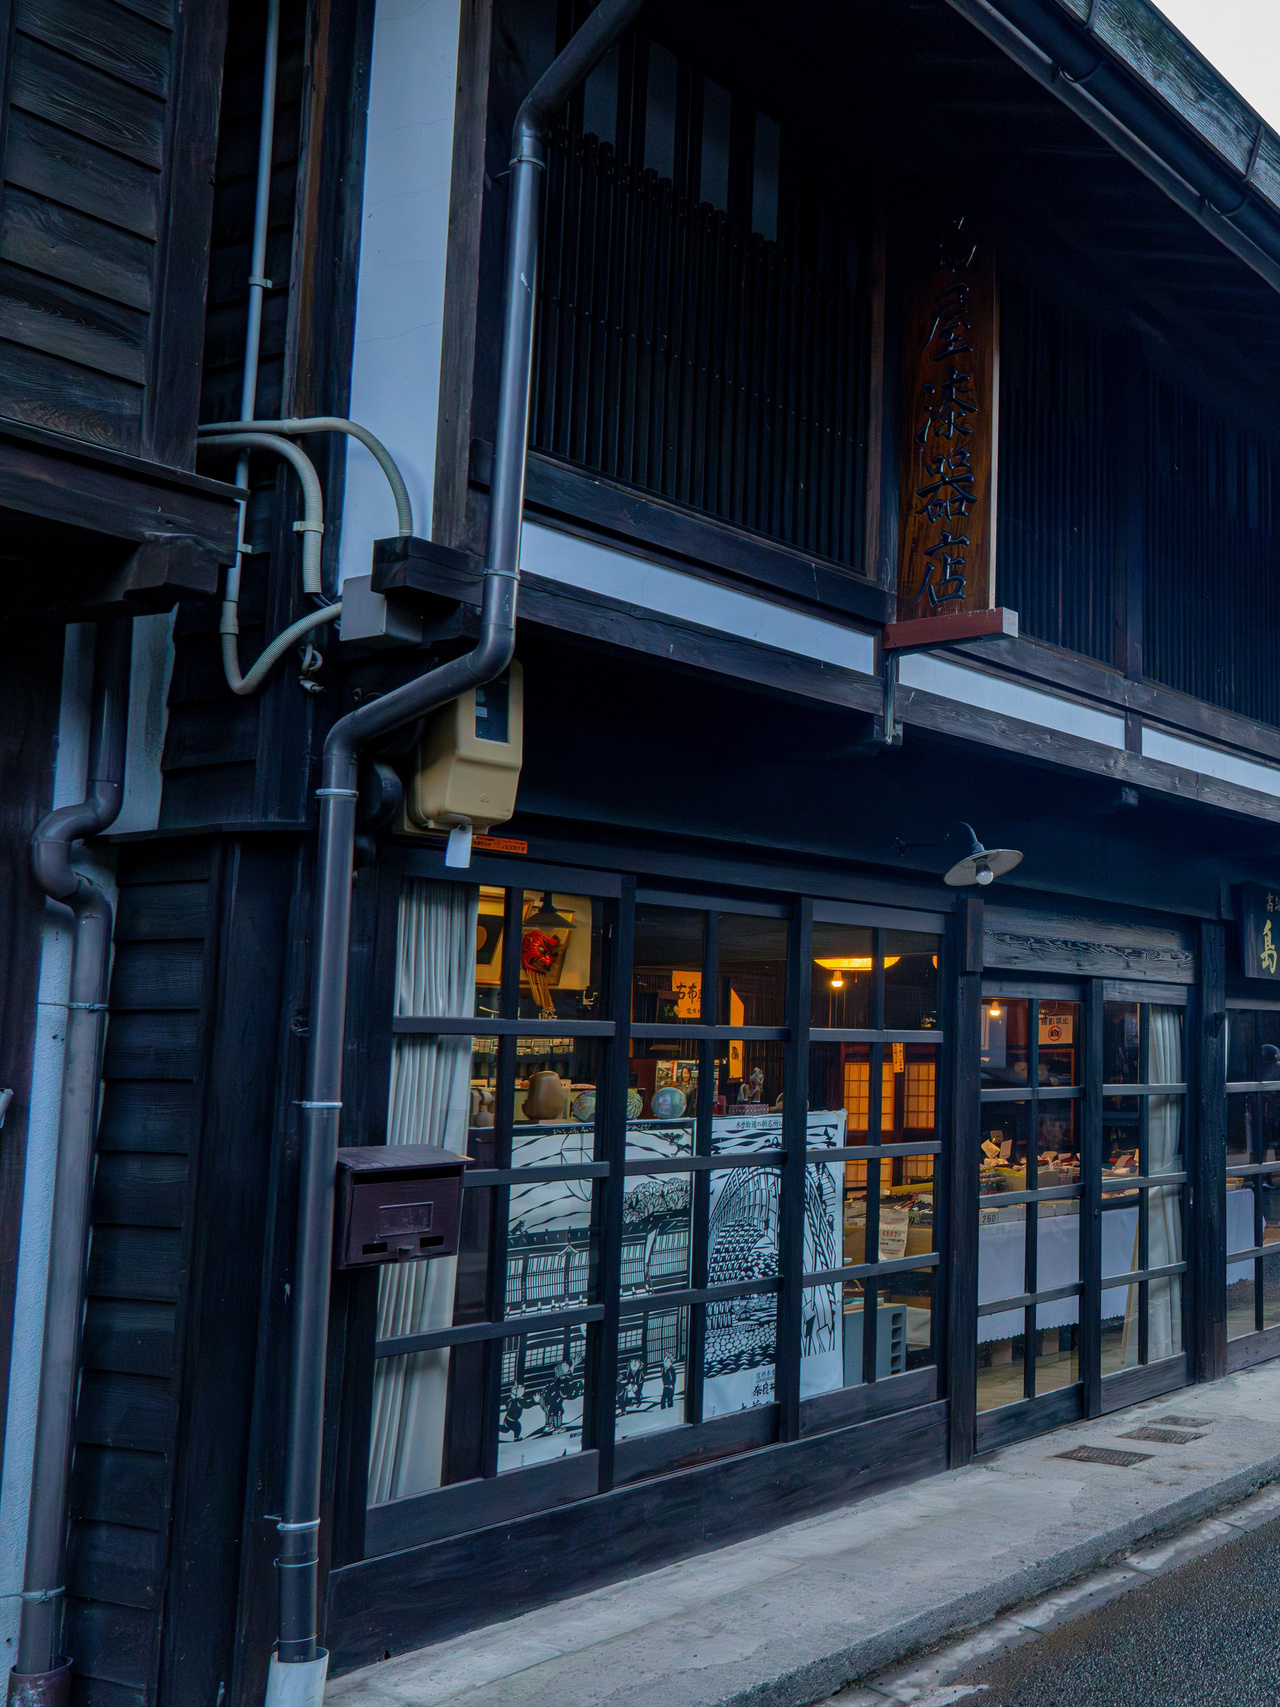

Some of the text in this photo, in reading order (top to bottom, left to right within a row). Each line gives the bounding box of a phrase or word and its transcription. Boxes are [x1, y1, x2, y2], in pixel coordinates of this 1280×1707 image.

[915, 217, 979, 608] 屋漆器店
[676, 982, 702, 1004] 古布
[982, 1214, 996, 1224] 250
